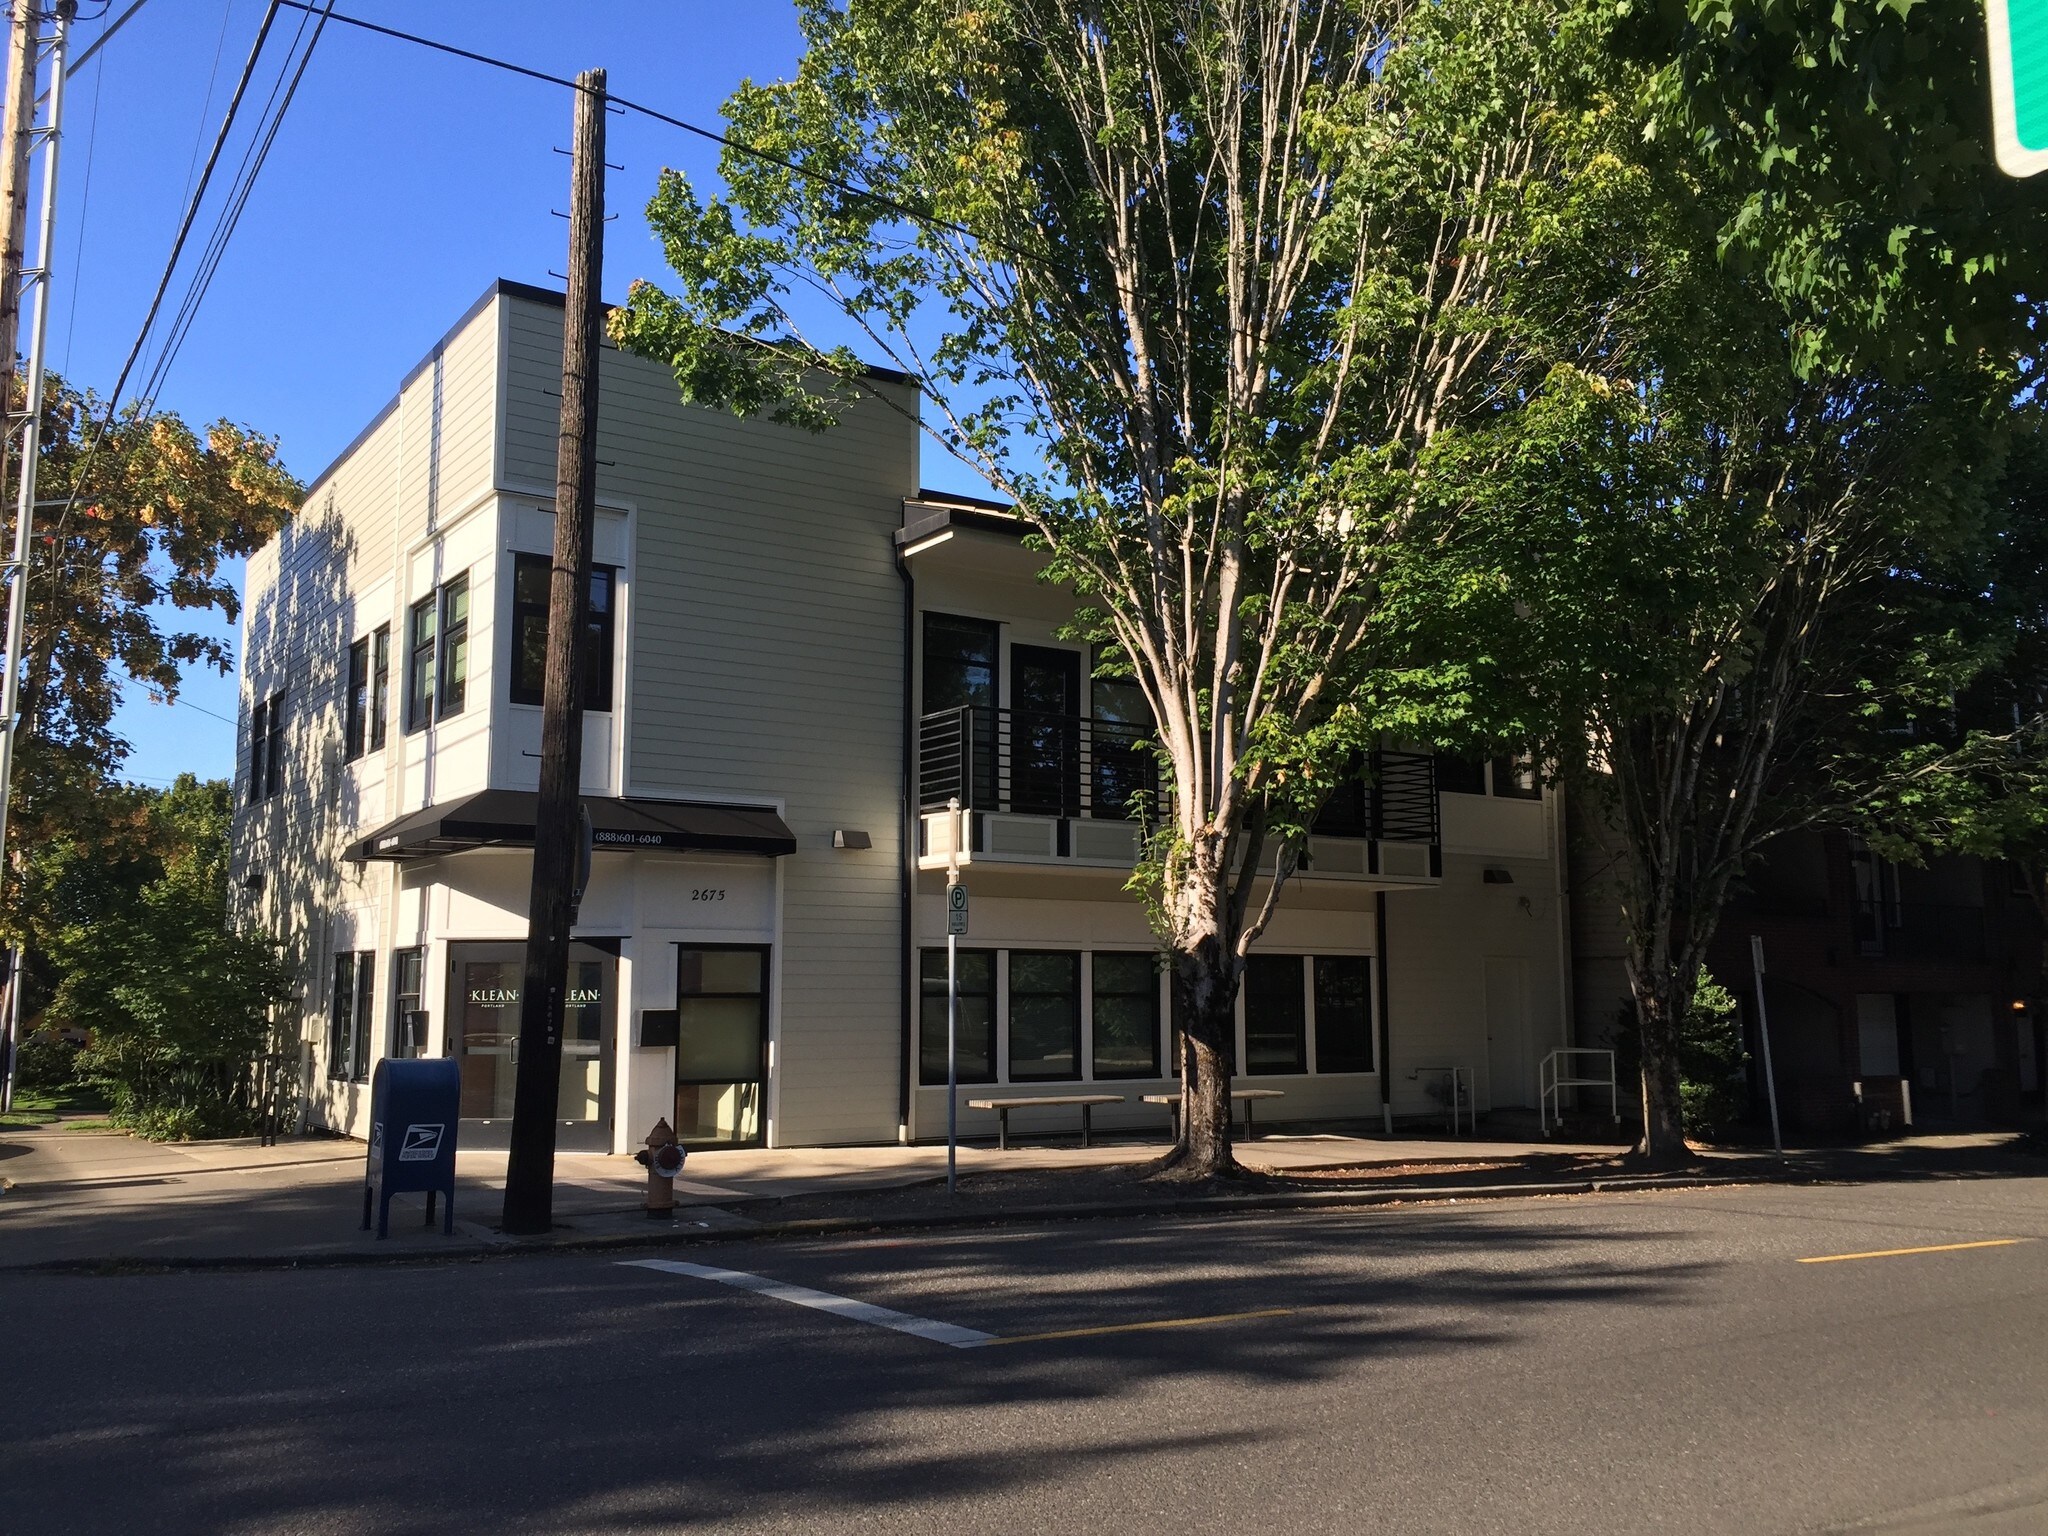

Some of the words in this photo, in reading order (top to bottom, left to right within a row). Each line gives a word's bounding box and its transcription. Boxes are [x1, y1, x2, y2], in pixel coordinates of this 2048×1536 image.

[595, 831, 662, 844] (888)601-6040
[692, 889, 726, 901] 2675
[955, 891, 962, 905] P
[565, 989, 598, 1001] EAN
